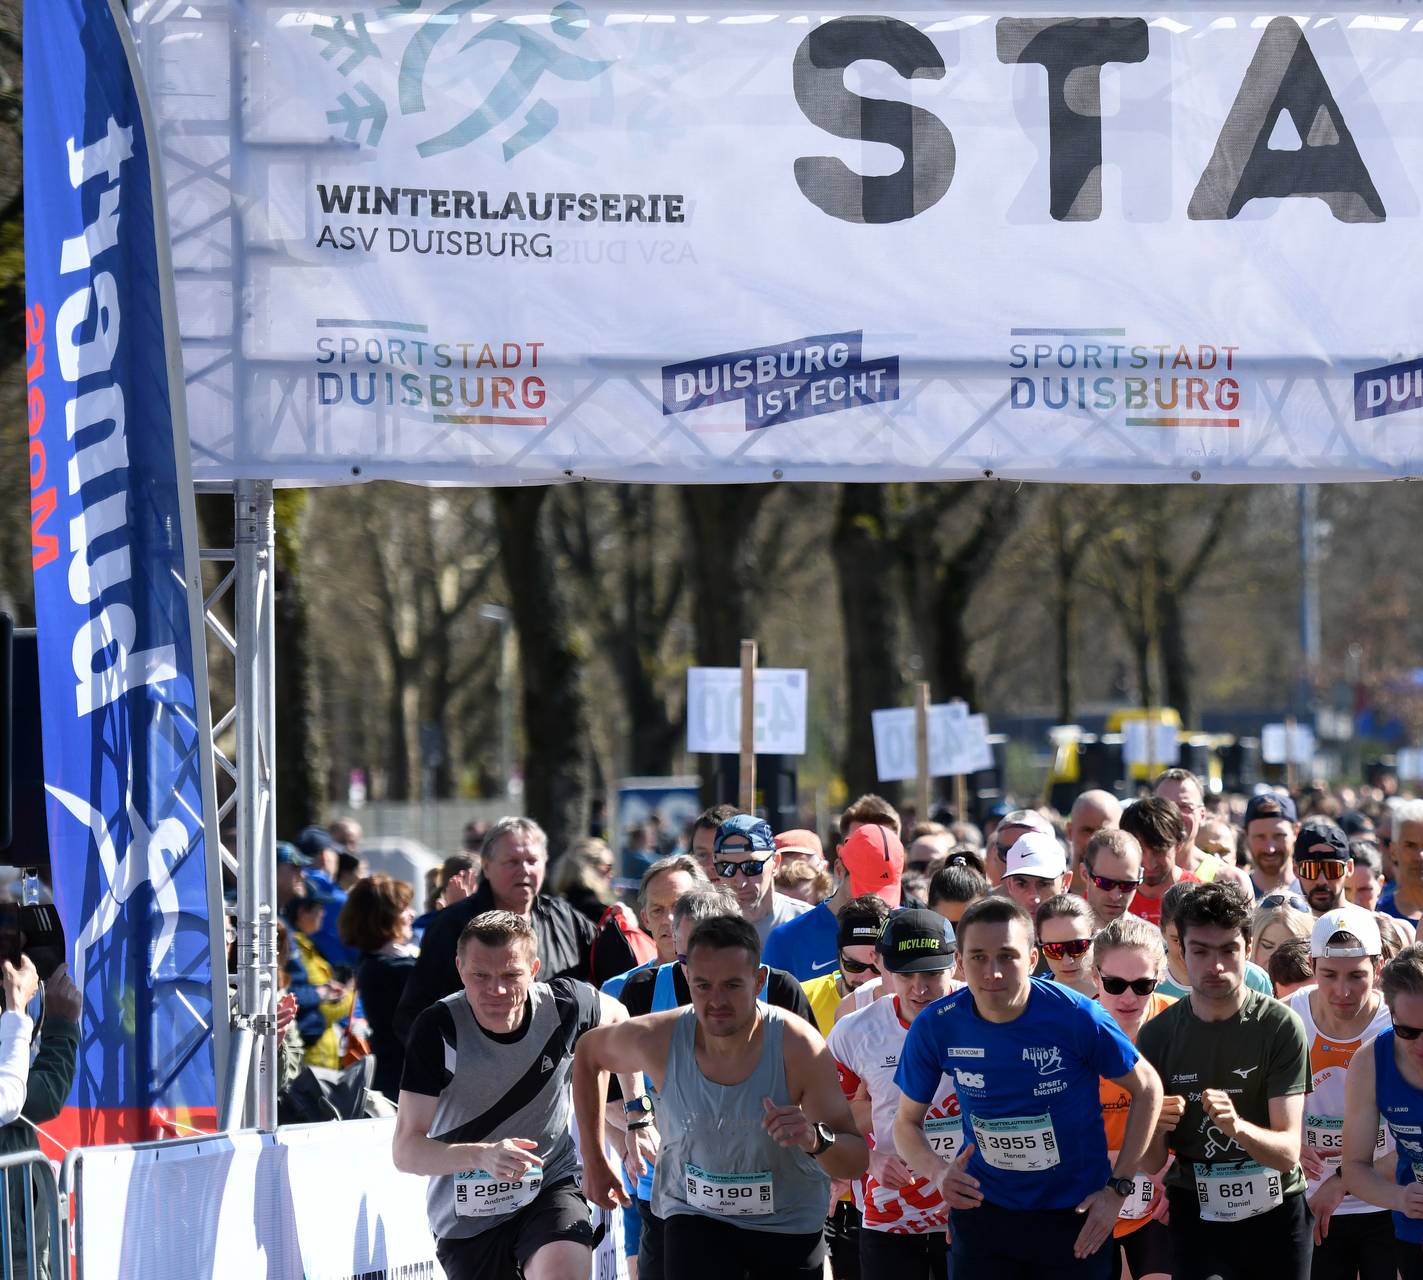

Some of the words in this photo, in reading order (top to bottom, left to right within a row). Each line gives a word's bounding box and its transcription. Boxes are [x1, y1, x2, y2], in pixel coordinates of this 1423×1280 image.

[316, 184, 686, 223] WINTERLAUFSERIE
[316, 226, 378, 253] ASV
[389, 227, 553, 258] DUISBURG
[316, 337, 546, 367] SPORTSTADT
[1009, 343, 1239, 370] SPORTSTADT
[674, 342, 850, 403] DUISBURG
[317, 372, 547, 410] DUISBURG
[757, 385, 802, 418] IST
[810, 368, 887, 406] ECHT
[1010, 376, 1240, 411] DUISBURG
[930, 1137, 955, 1150] 72
[988, 1135, 1036, 1150] 3955
[1322, 1134, 1343, 1147] 33
[475, 1181, 523, 1197] 2999
[484, 1194, 514, 1206] Andreas
[703, 1185, 753, 1199] 2190
[1219, 1181, 1254, 1198] 681
[1227, 1199, 1251, 1209] Daniel
